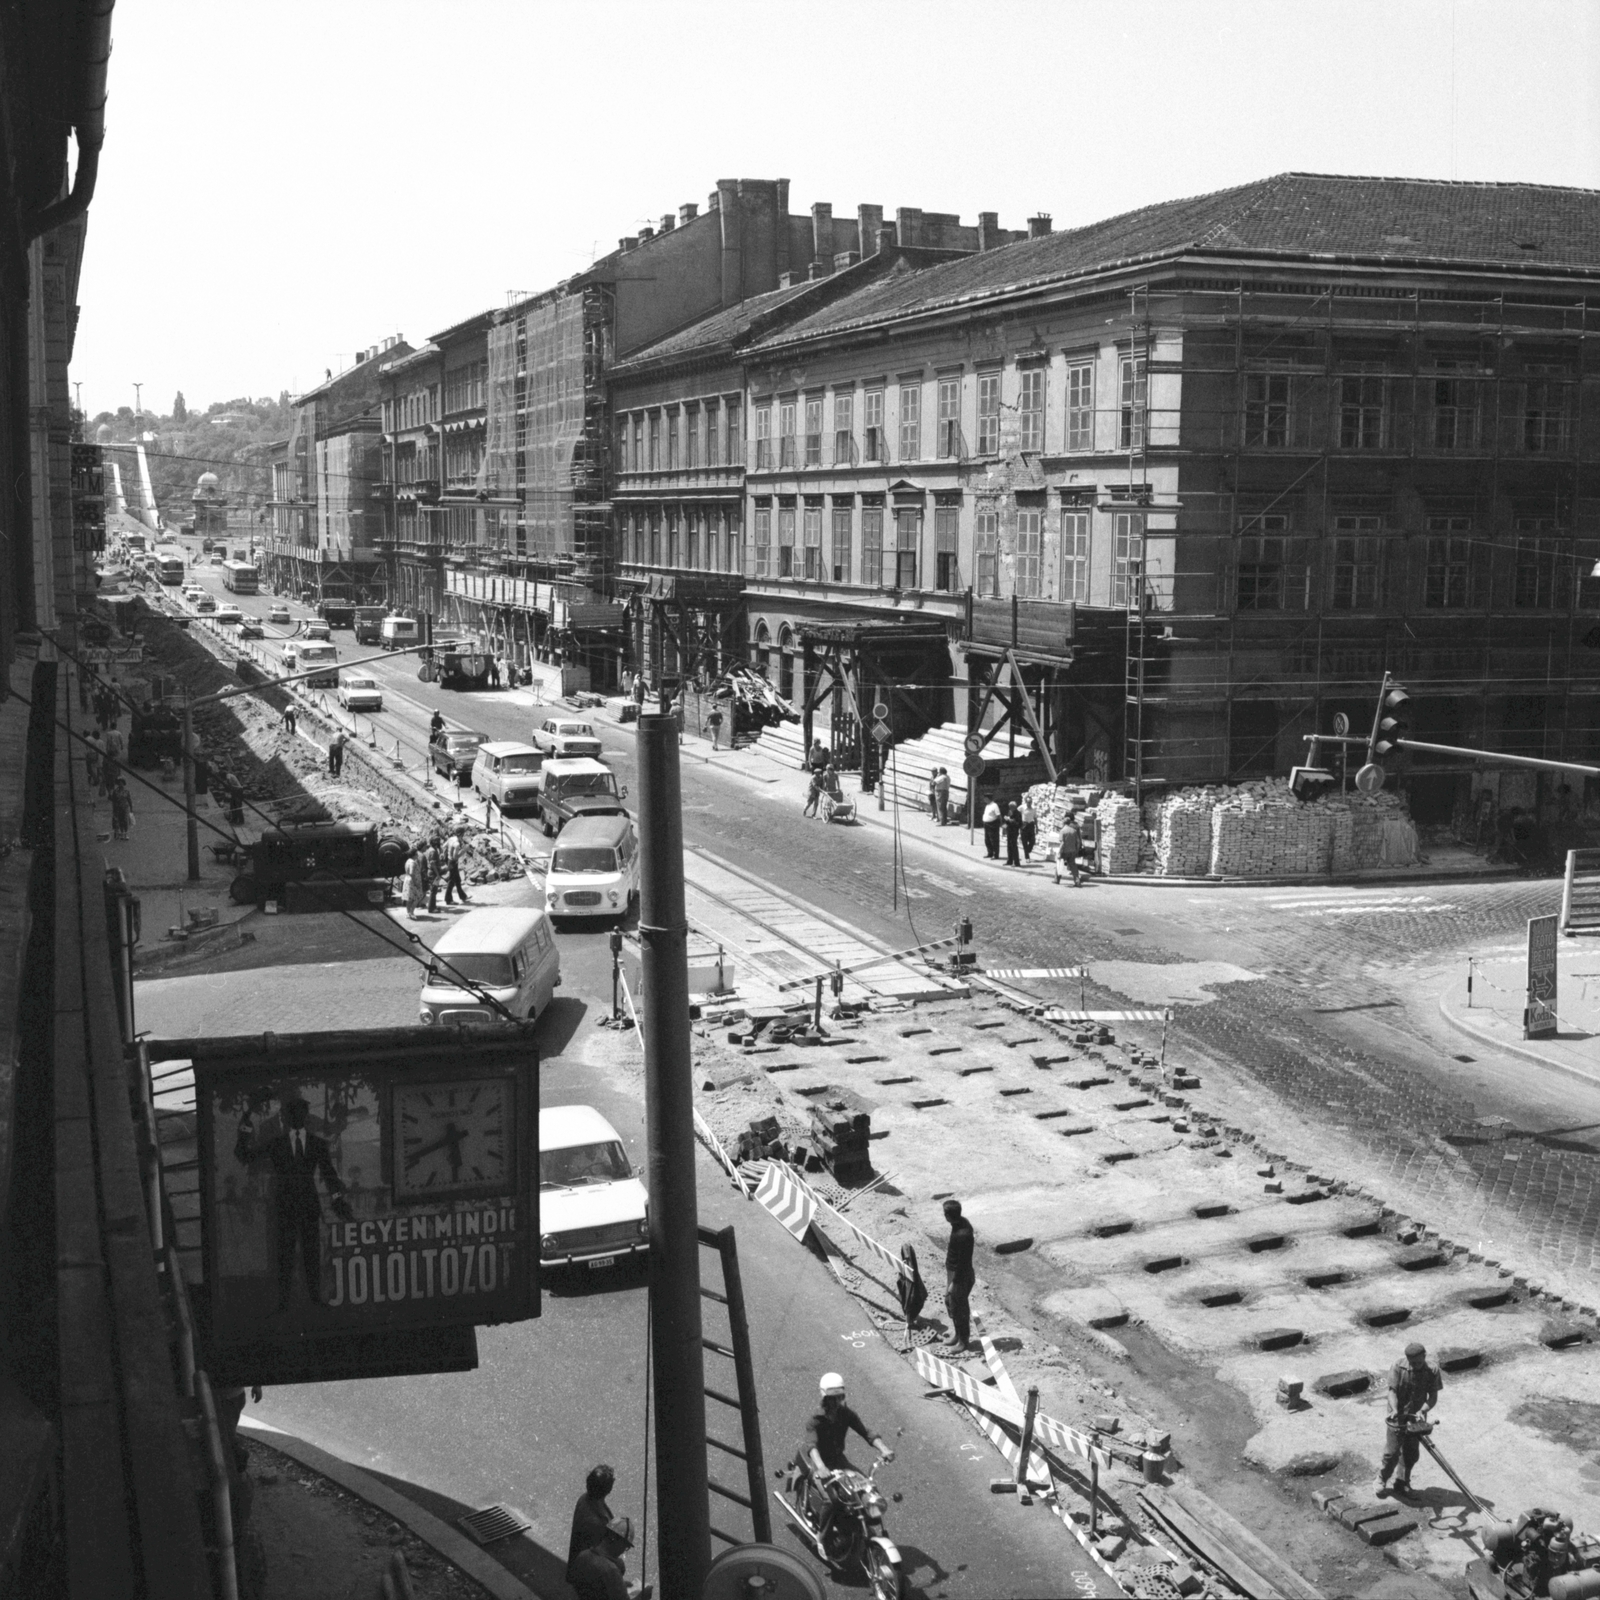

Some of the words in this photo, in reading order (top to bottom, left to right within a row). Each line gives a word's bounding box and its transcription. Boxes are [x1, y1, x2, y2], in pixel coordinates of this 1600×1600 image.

[72, 475, 101, 493] FILM
[74, 530, 103, 550] FILM
[1530, 1004, 1556, 1024] Kodak
[331, 1216, 428, 1248] LEGYEN
